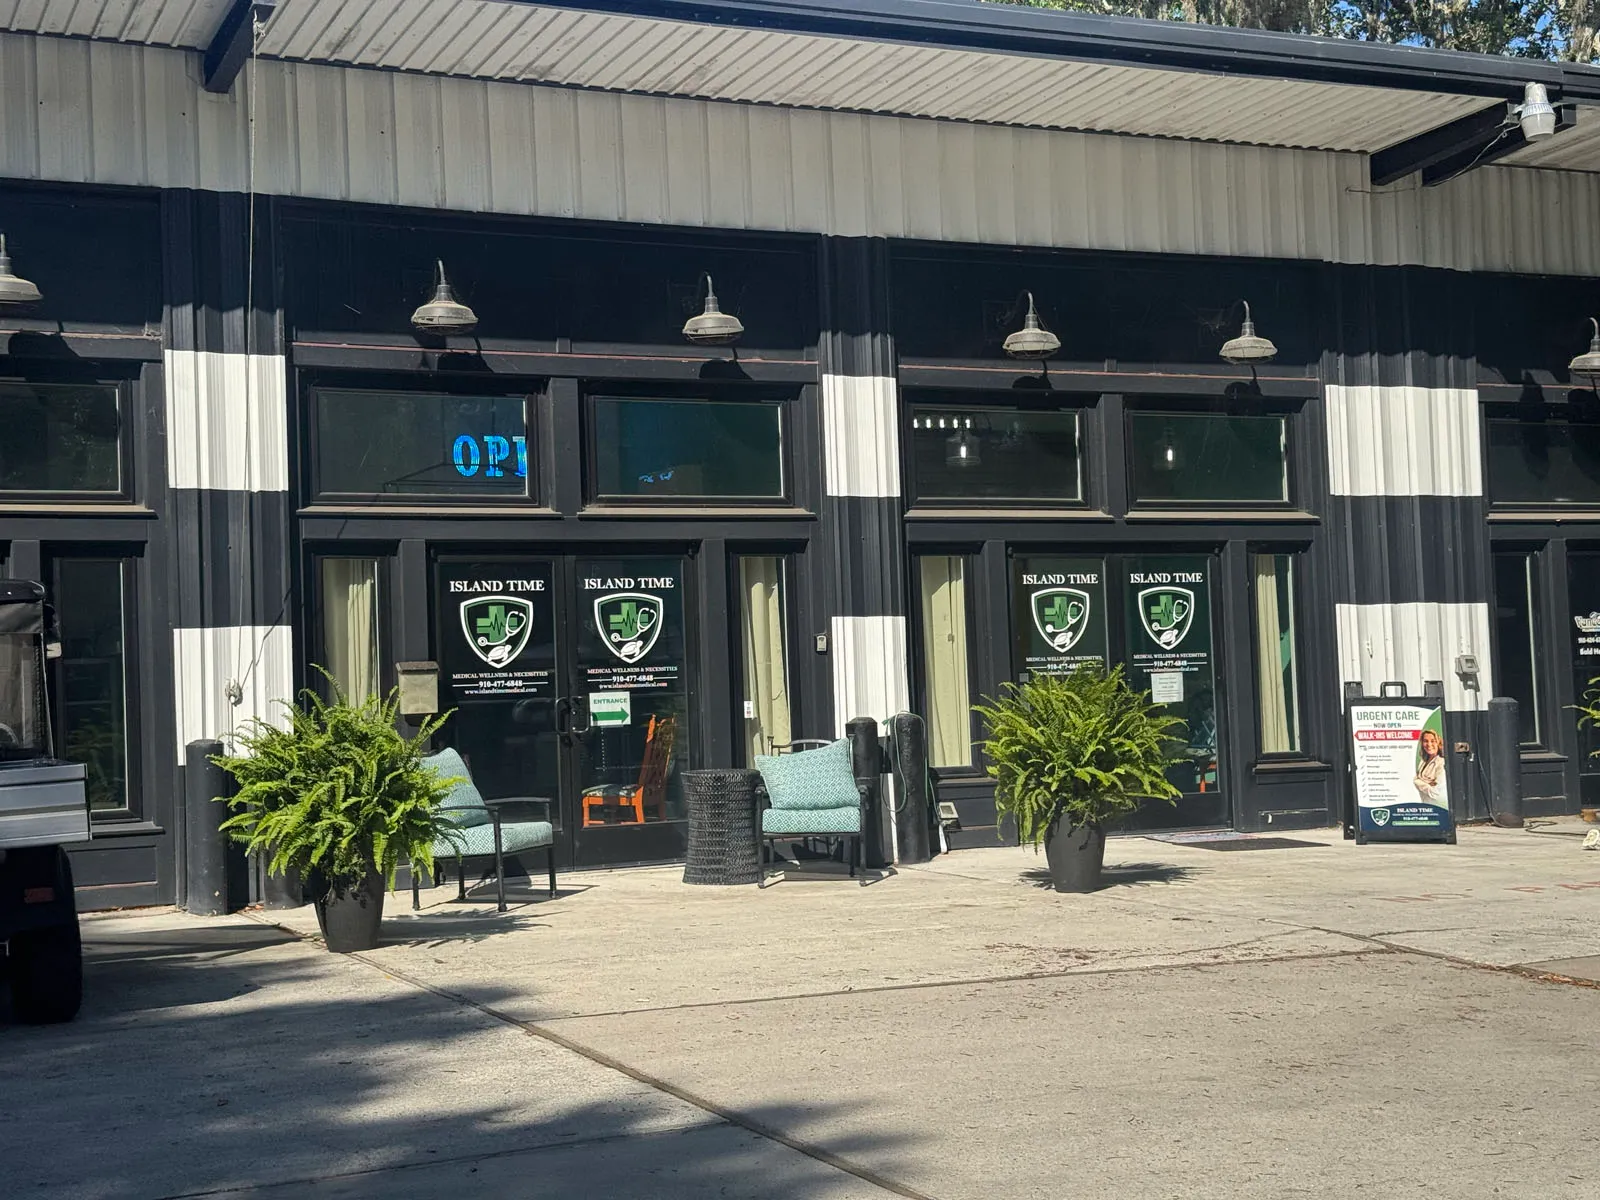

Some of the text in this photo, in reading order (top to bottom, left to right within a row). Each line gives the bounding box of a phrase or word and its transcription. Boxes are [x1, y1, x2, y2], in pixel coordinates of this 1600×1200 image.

[1022, 574, 1098, 585] ISLAND TIME
[1130, 572, 1203, 584] ISLAND TIME
[449, 580, 545, 592] ISLAND TIME
[584, 577, 674, 590] ISLAND TIME
[478, 680, 523, 688] 910-477-6848
[464, 687, 537, 695] www.islandtimemedical.com
[1356, 711, 1421, 721] URGENT CARE
[1357, 731, 1414, 740] WALK-INS WELCOME
